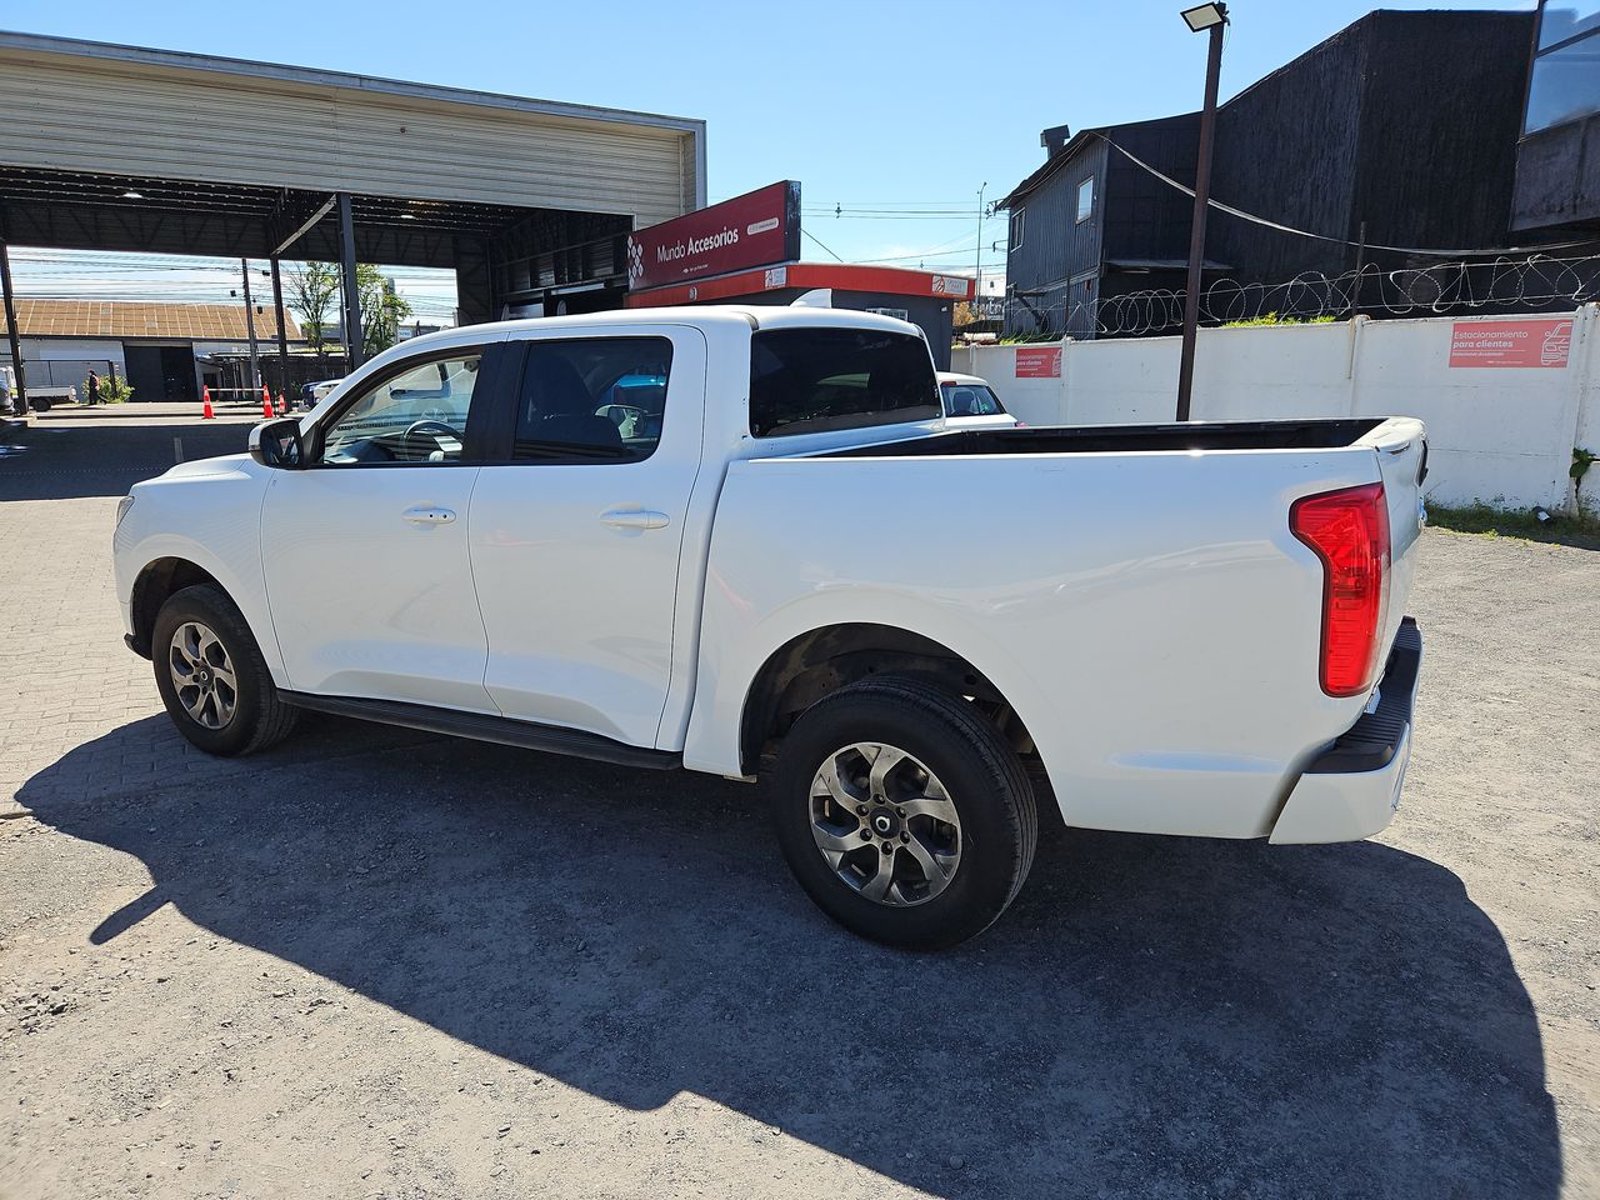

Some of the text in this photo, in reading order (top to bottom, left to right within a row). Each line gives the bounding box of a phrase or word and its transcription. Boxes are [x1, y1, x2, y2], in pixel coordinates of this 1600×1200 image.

[657, 226, 739, 263] Mundo Accesorios
[1454, 331, 1528, 339] Estacionamiento
[1453, 340, 1513, 349] para clientes
